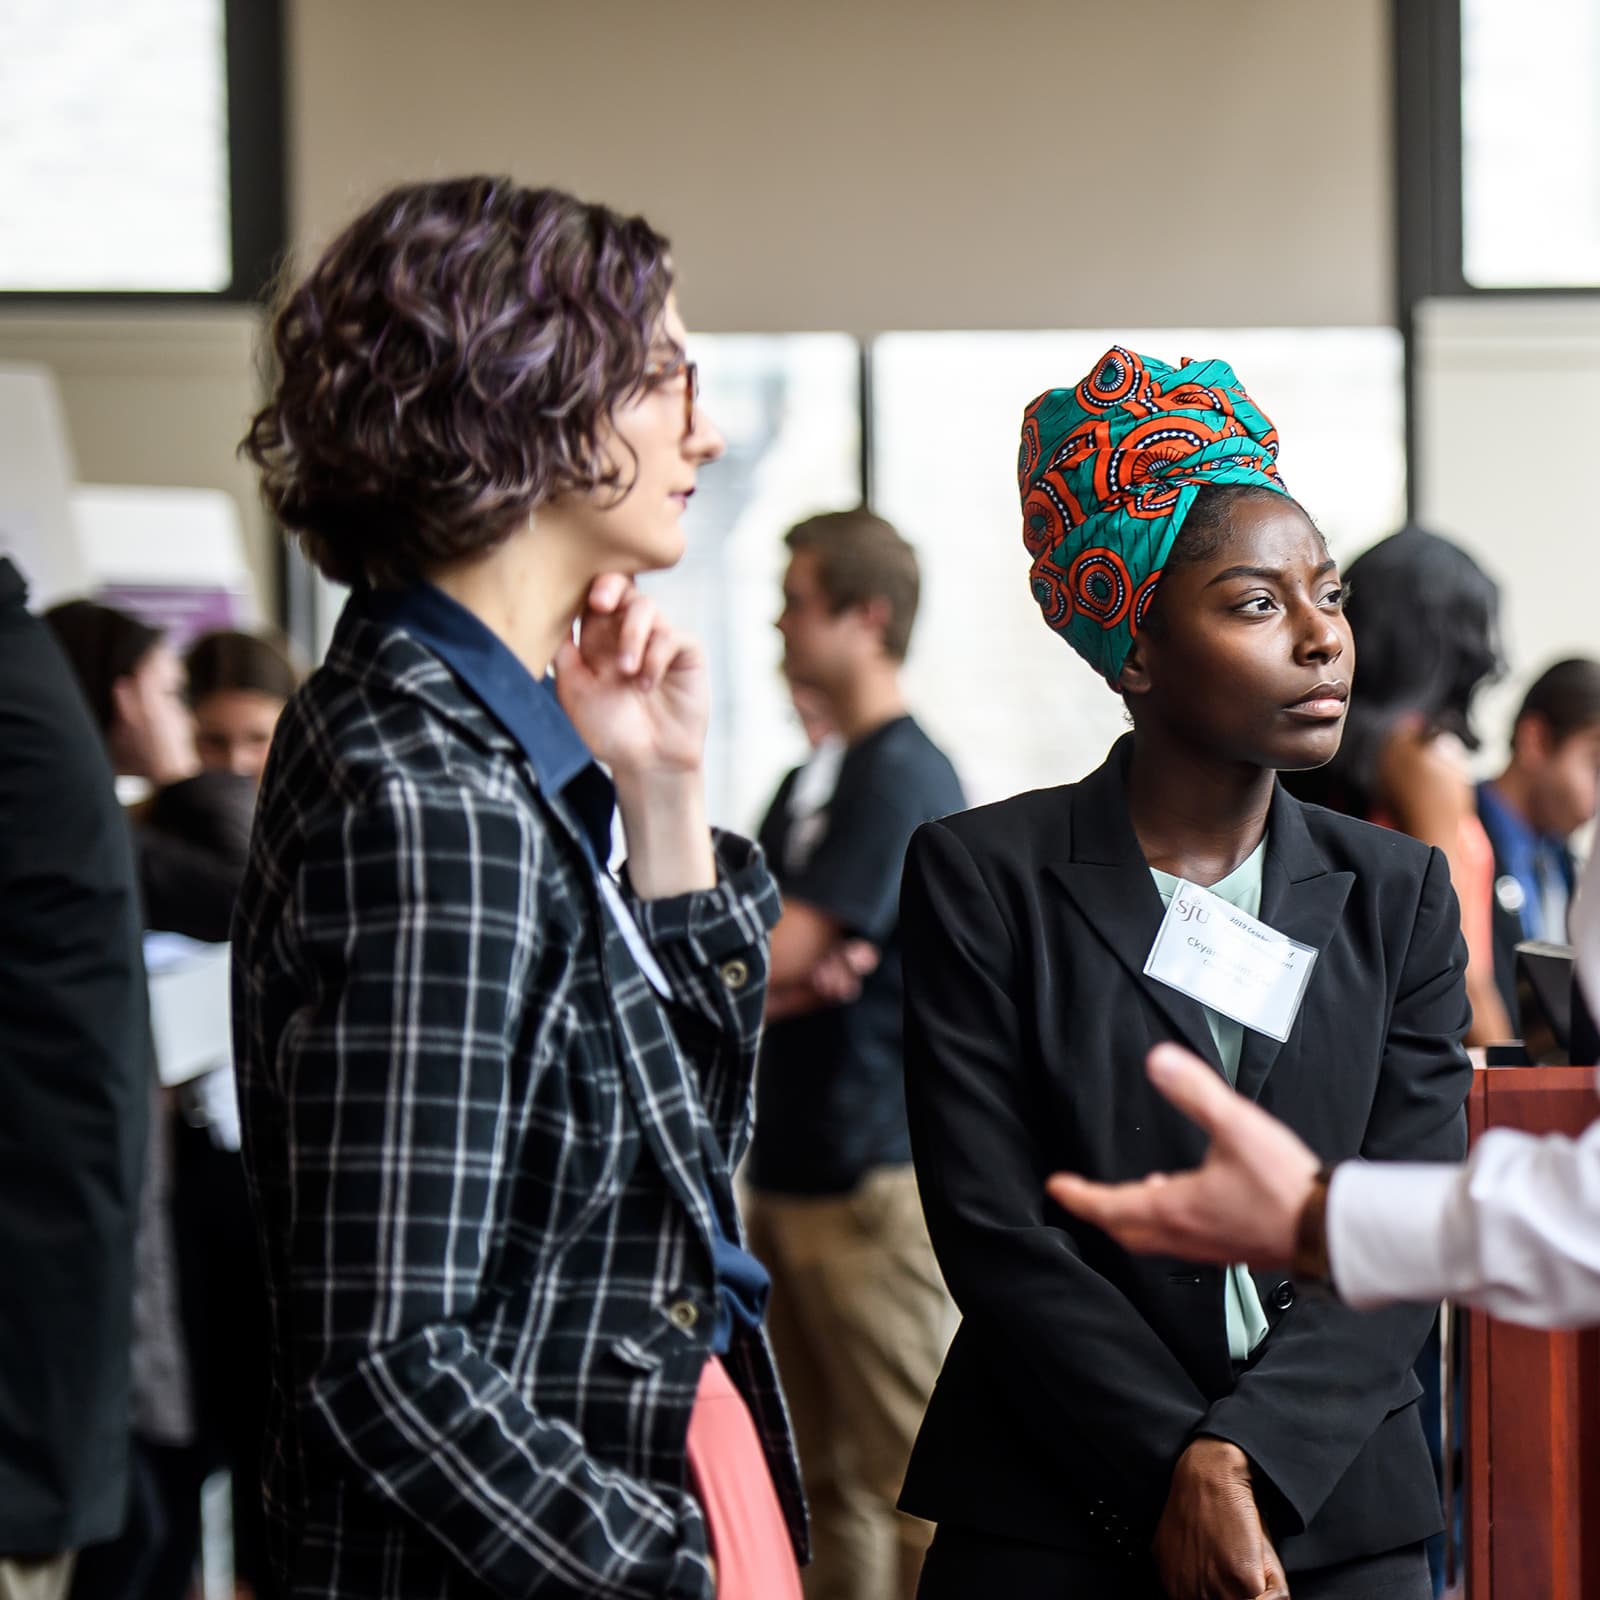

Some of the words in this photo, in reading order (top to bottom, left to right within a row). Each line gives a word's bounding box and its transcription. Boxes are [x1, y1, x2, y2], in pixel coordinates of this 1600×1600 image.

[1175, 899, 1211, 924] SJU
[1229, 917, 1247, 929] 2019
[1248, 927, 1272, 943] Celebr
